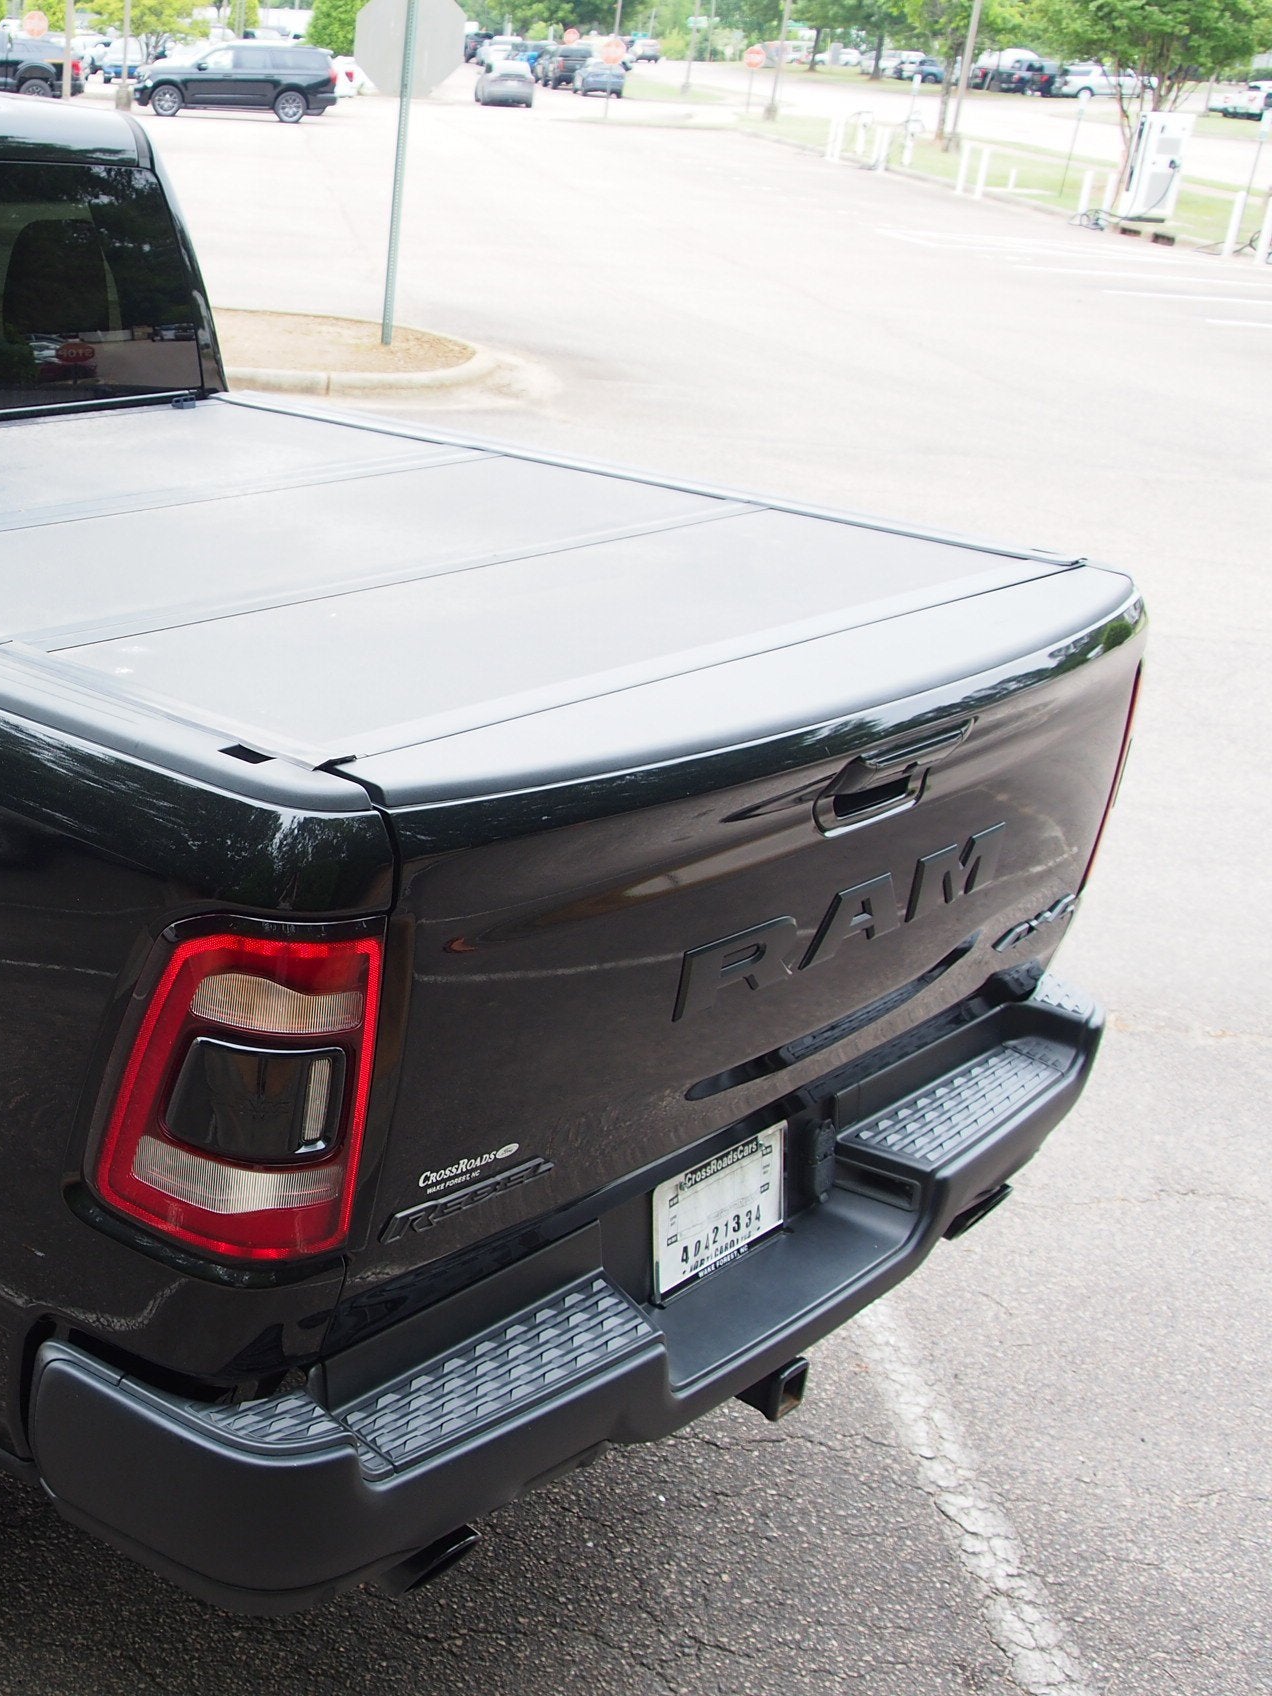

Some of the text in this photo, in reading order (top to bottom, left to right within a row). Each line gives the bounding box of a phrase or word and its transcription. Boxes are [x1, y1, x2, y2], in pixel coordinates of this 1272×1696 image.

[671, 820, 1007, 1023] RAM
[379, 1155, 555, 1245] REBEL
[684, 1140, 759, 1188] CrossRoadsCars
